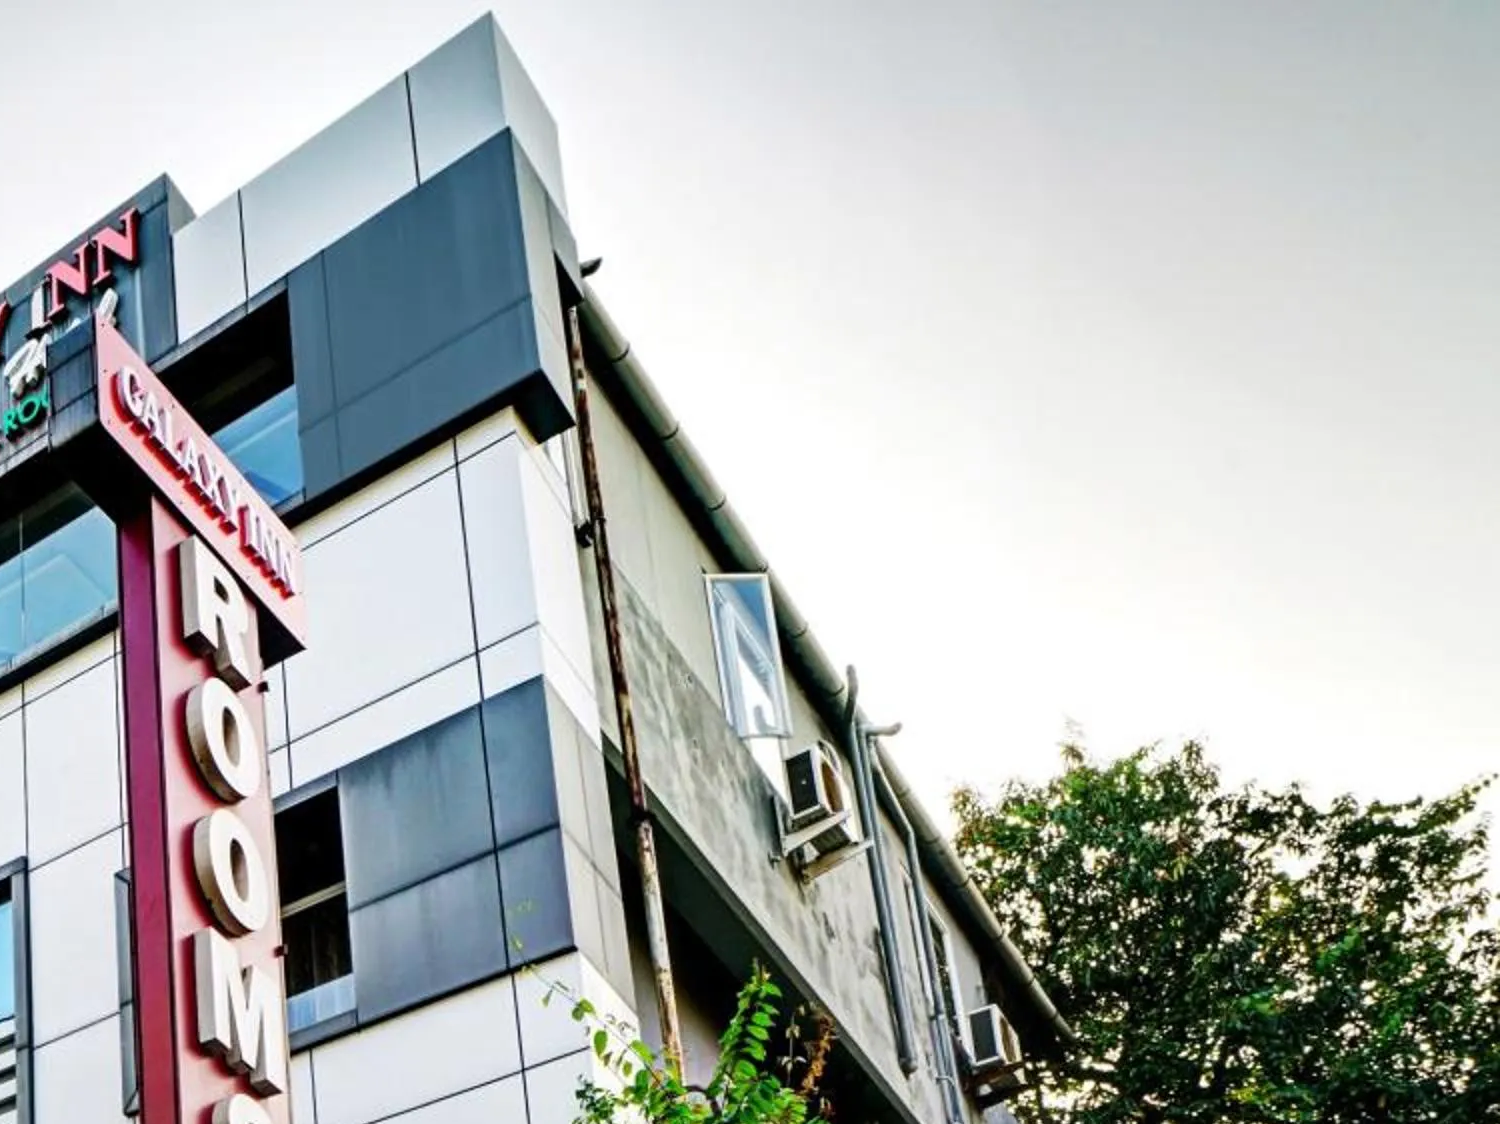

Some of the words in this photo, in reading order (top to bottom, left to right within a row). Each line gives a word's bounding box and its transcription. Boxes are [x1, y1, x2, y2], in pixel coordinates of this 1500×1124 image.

[30, 207, 140, 335] INN
[111, 366, 238, 536] GALAXY
[237, 505, 296, 600] INN
